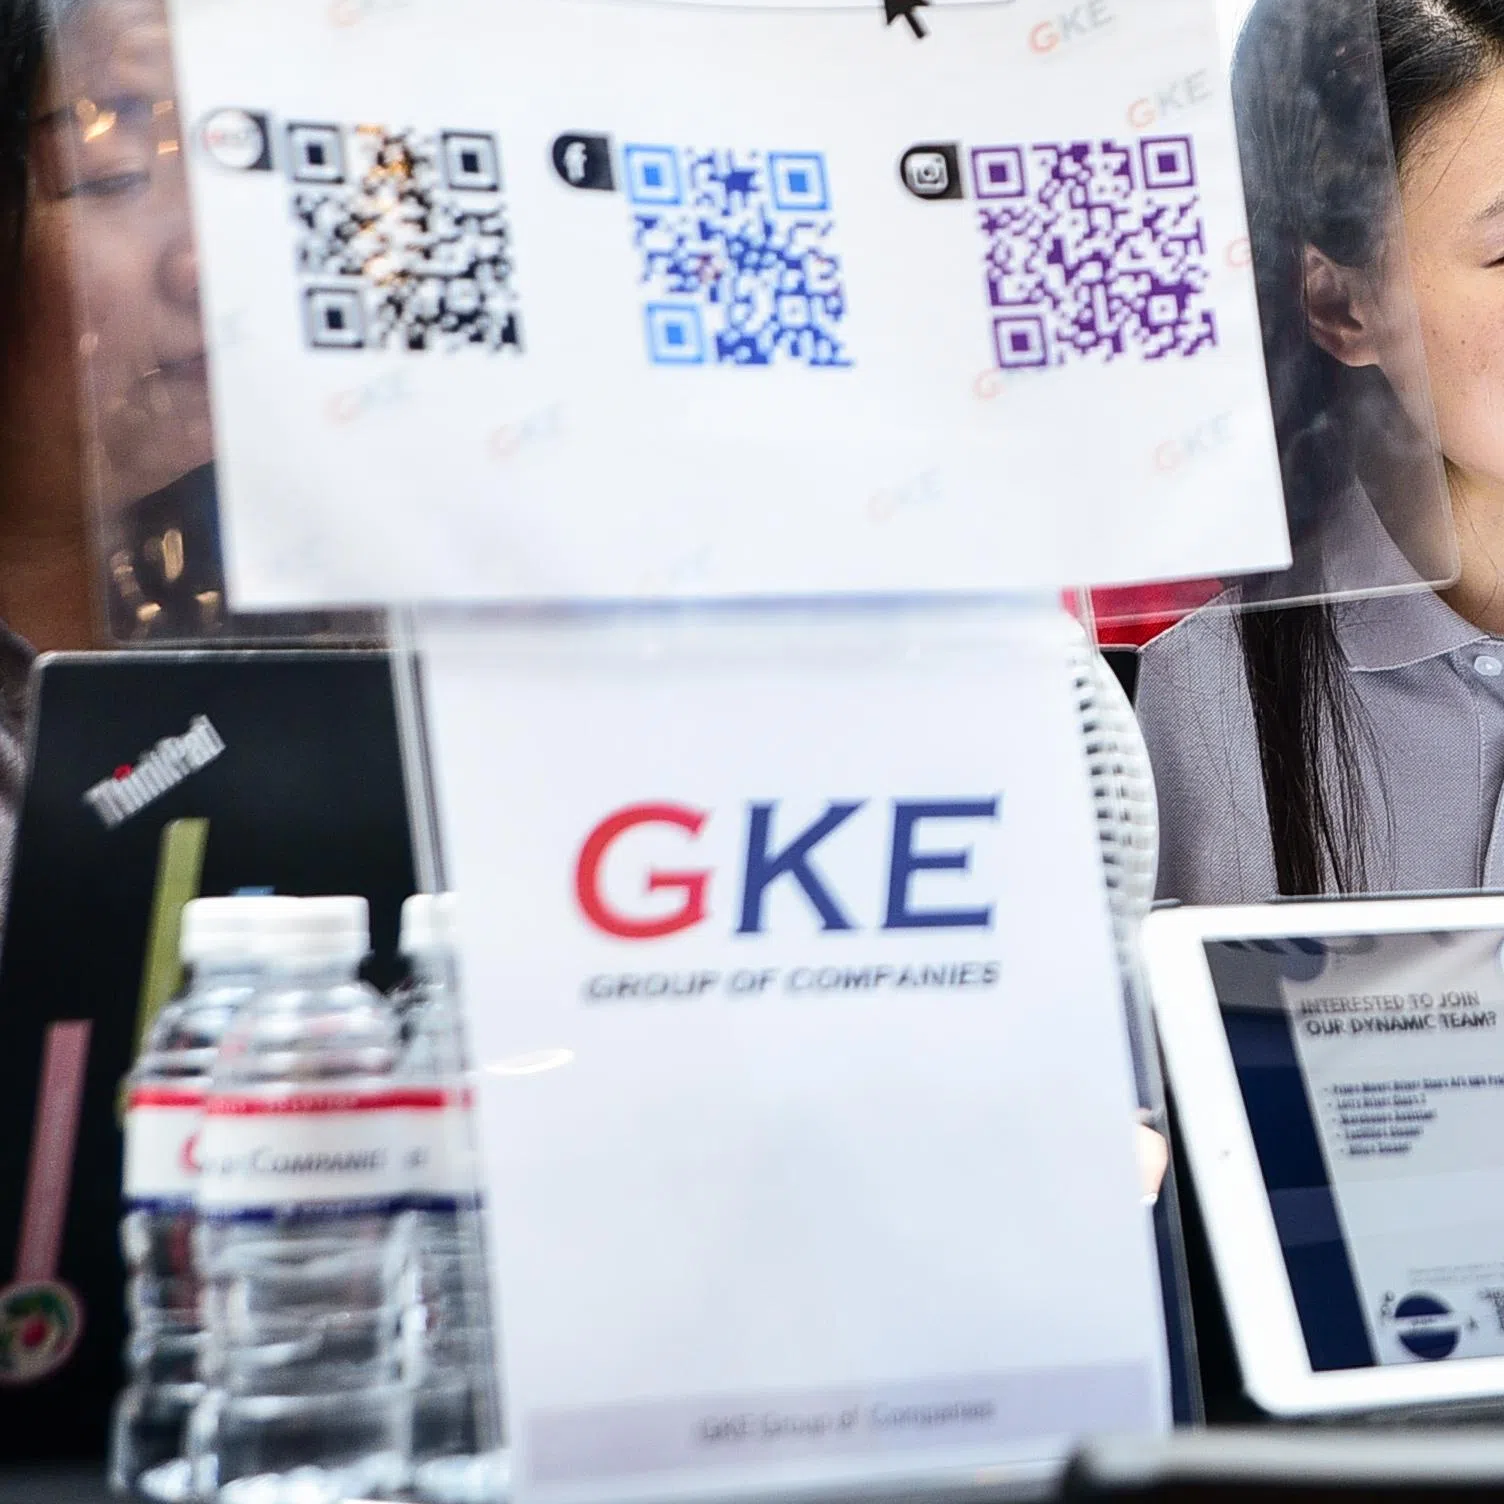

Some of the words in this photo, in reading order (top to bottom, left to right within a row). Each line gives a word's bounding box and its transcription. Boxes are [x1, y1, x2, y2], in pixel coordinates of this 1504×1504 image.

[571, 789, 1005, 942] GKE
[583, 969, 720, 1003] GROUP
[728, 968, 777, 996] OF
[788, 959, 1002, 994] COMPANIES
[1301, 994, 1405, 1015] INTERESTED
[1409, 992, 1434, 1009] TO
[1438, 991, 1480, 1008] JOIN
[1305, 1018, 1346, 1036] OUR
[1350, 1012, 1437, 1034] DYNAMIC
[1440, 1010, 1498, 1029] TEAM?
